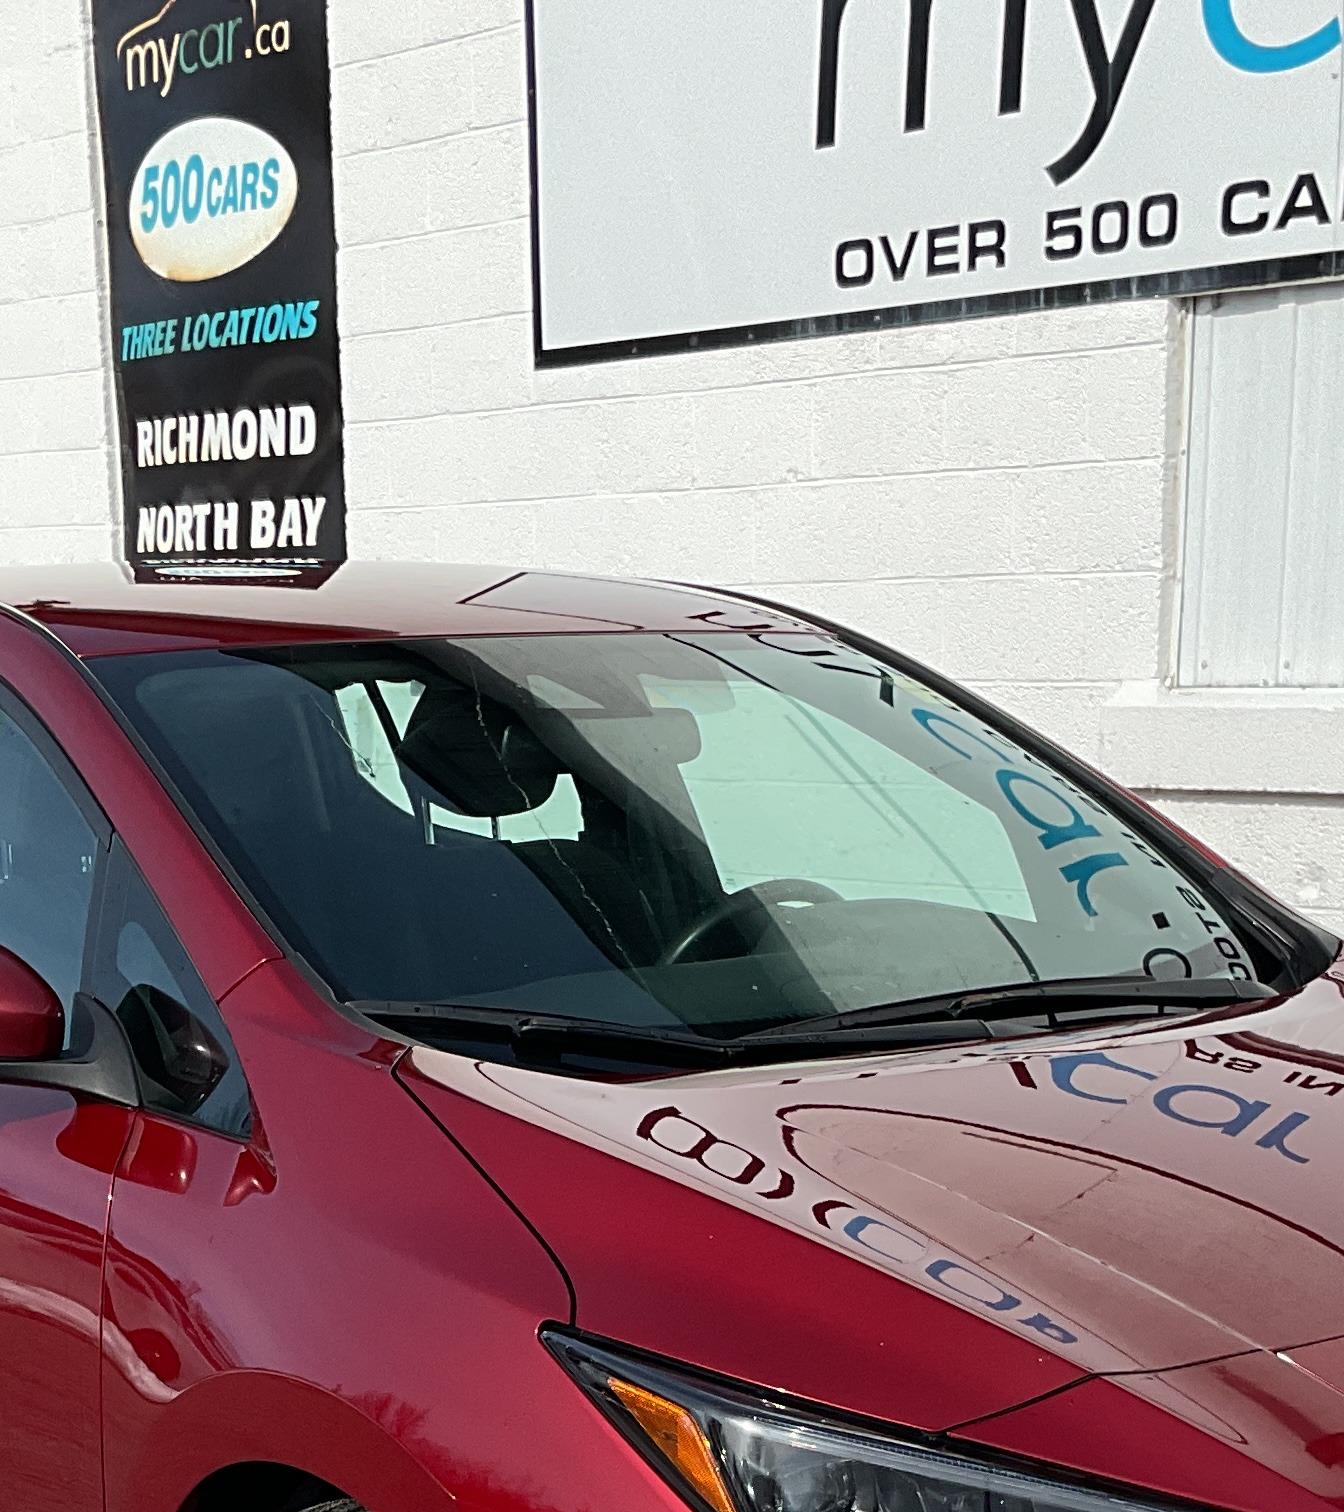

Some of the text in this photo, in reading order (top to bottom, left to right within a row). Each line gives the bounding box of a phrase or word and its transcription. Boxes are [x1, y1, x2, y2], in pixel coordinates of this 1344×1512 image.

[834, 220, 1007, 289] OVER
[1044, 193, 1178, 261] 500
[121, 300, 320, 361] THREE LOCATIONS
[136, 404, 317, 467] RICHMOND
[137, 497, 326, 553] NORTH BAY
